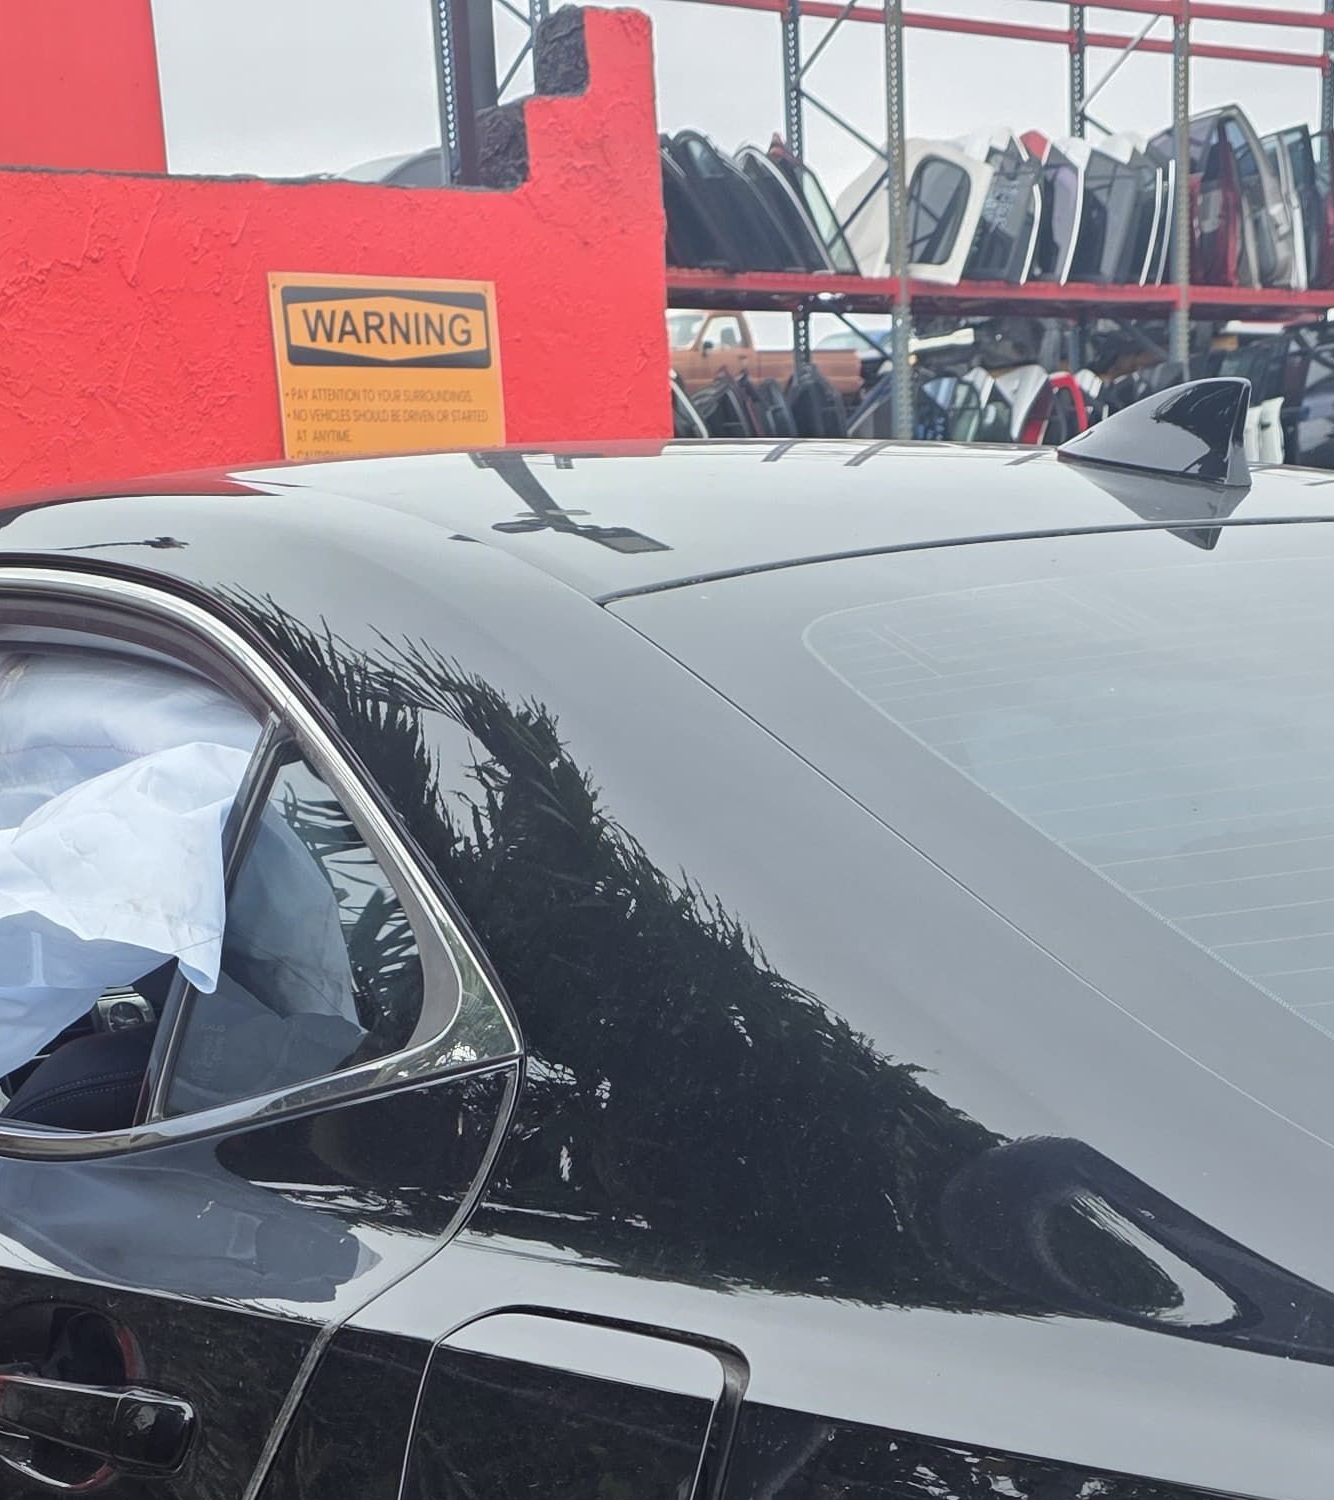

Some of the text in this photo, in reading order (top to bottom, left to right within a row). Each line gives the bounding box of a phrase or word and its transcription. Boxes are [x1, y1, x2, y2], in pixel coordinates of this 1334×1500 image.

[302, 308, 472, 347] WARNING
[291, 387, 309, 401] PAY
[311, 387, 361, 402] ATTENTION
[362, 388, 375, 402] TO
[377, 388, 401, 402] YOUR
[293, 408, 490, 423] NO VEHICLES SHOULD BE DRIVEN OR STARTED
[296, 429, 308, 442] AT
